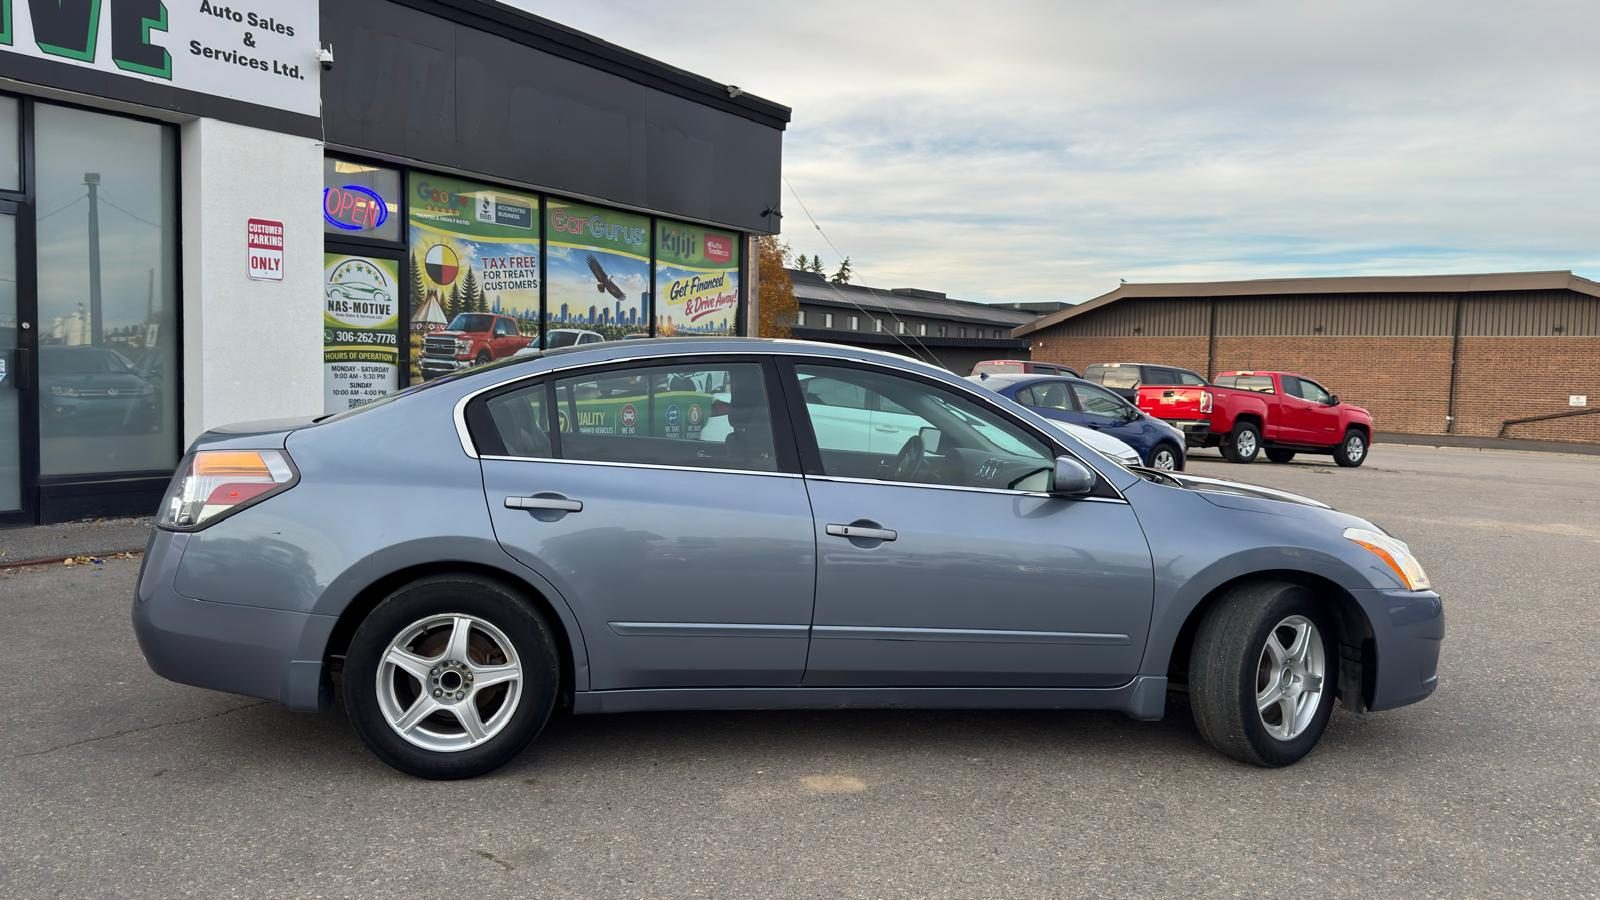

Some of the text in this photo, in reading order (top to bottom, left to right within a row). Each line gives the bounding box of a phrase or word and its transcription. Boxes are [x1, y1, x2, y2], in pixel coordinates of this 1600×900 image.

[200, 0, 295, 37] Auto Sales
[243, 31, 257, 48] &
[189, 39, 305, 80] Services Ltd.
[326, 187, 378, 228] OPEN
[249, 223, 282, 236] CUSTOMER
[552, 208, 643, 245] CarGurus
[249, 233, 282, 247] PARKING
[251, 255, 280, 271] ONLY
[482, 256, 536, 270] TAX FREE
[483, 269, 535, 280] FOR TREATY
[484, 280, 537, 291] CUSTOMERS
[670, 271, 725, 301] Get Financed
[327, 300, 391, 315] NAS-MOTIVE
[685, 289, 738, 316] & Drive Away!
[336, 331, 397, 344] 306-262-7778
[325, 352, 393, 361] HOURS OF OPERATION
[577, 412, 605, 426] UALITY
